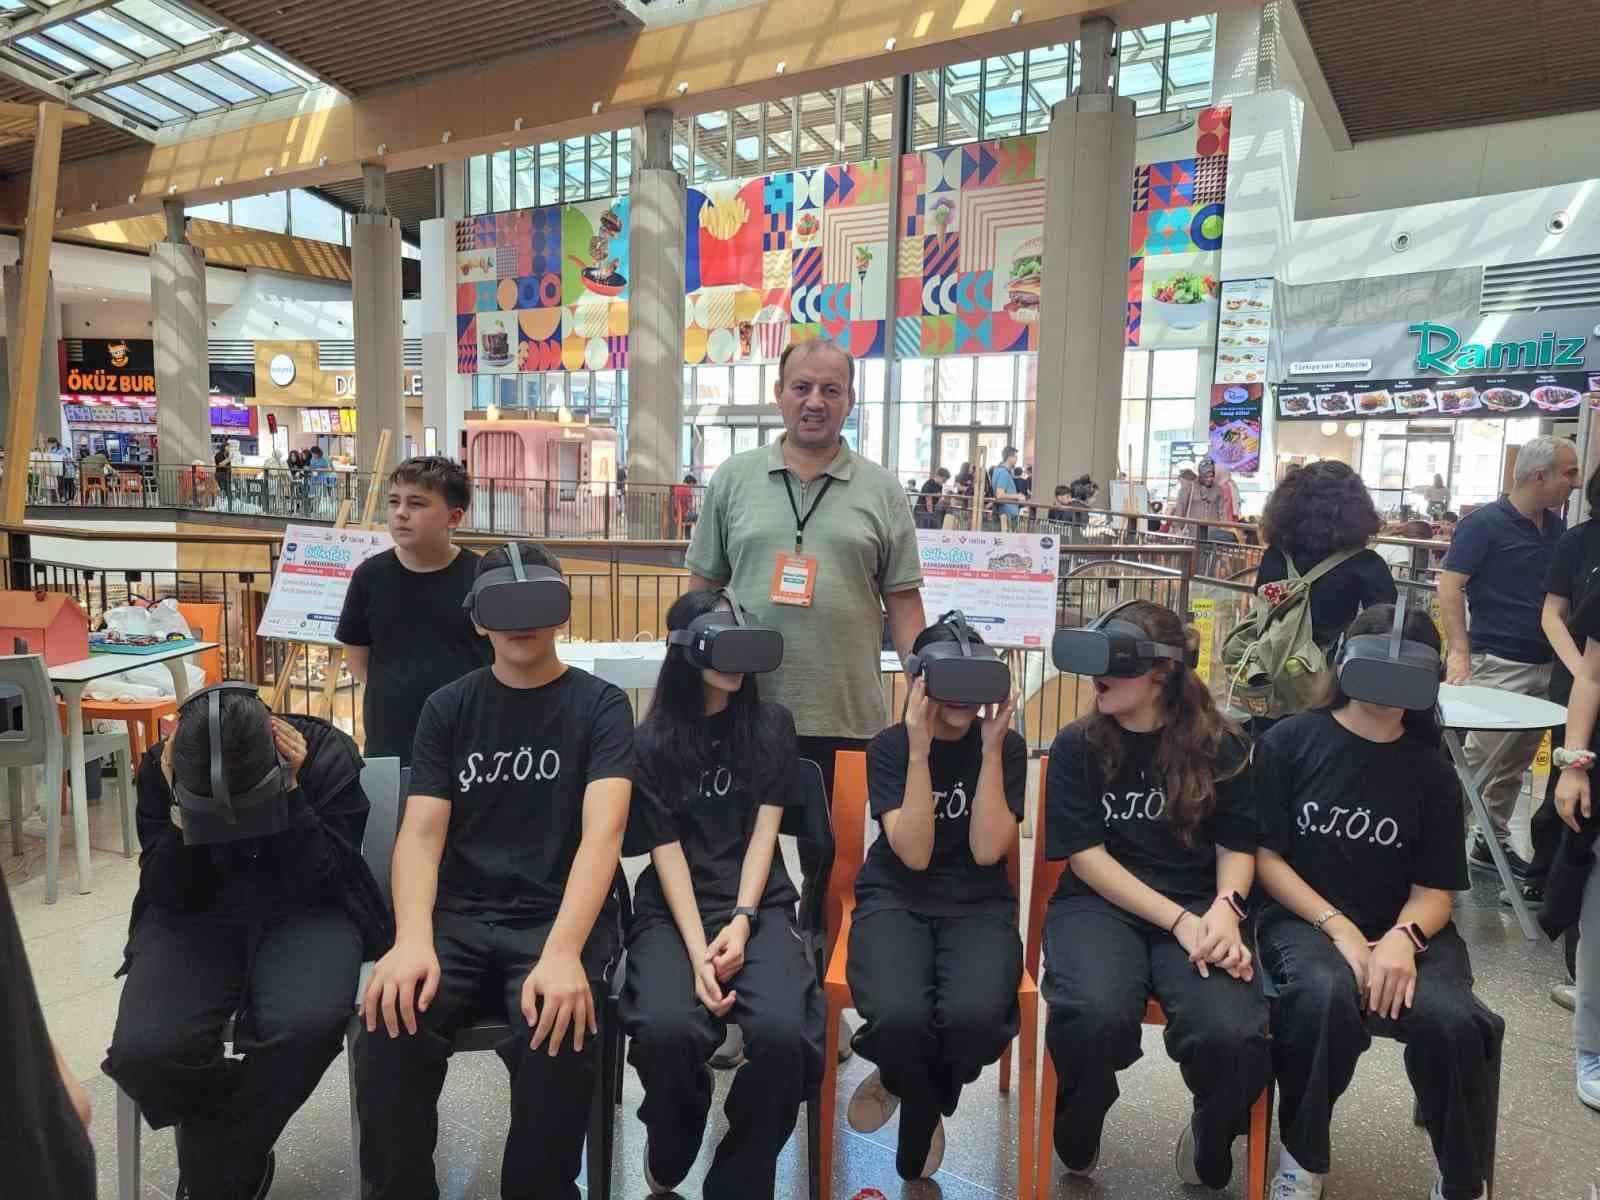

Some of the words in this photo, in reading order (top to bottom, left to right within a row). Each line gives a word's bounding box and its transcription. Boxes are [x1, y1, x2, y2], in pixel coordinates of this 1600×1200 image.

[1408, 321, 1586, 376] Ramiz
[67, 369, 118, 392] ÖKÜZ
[120, 375, 155, 393] BUR
[1297, 801, 1403, 849] Ş.T.Ö.O.
